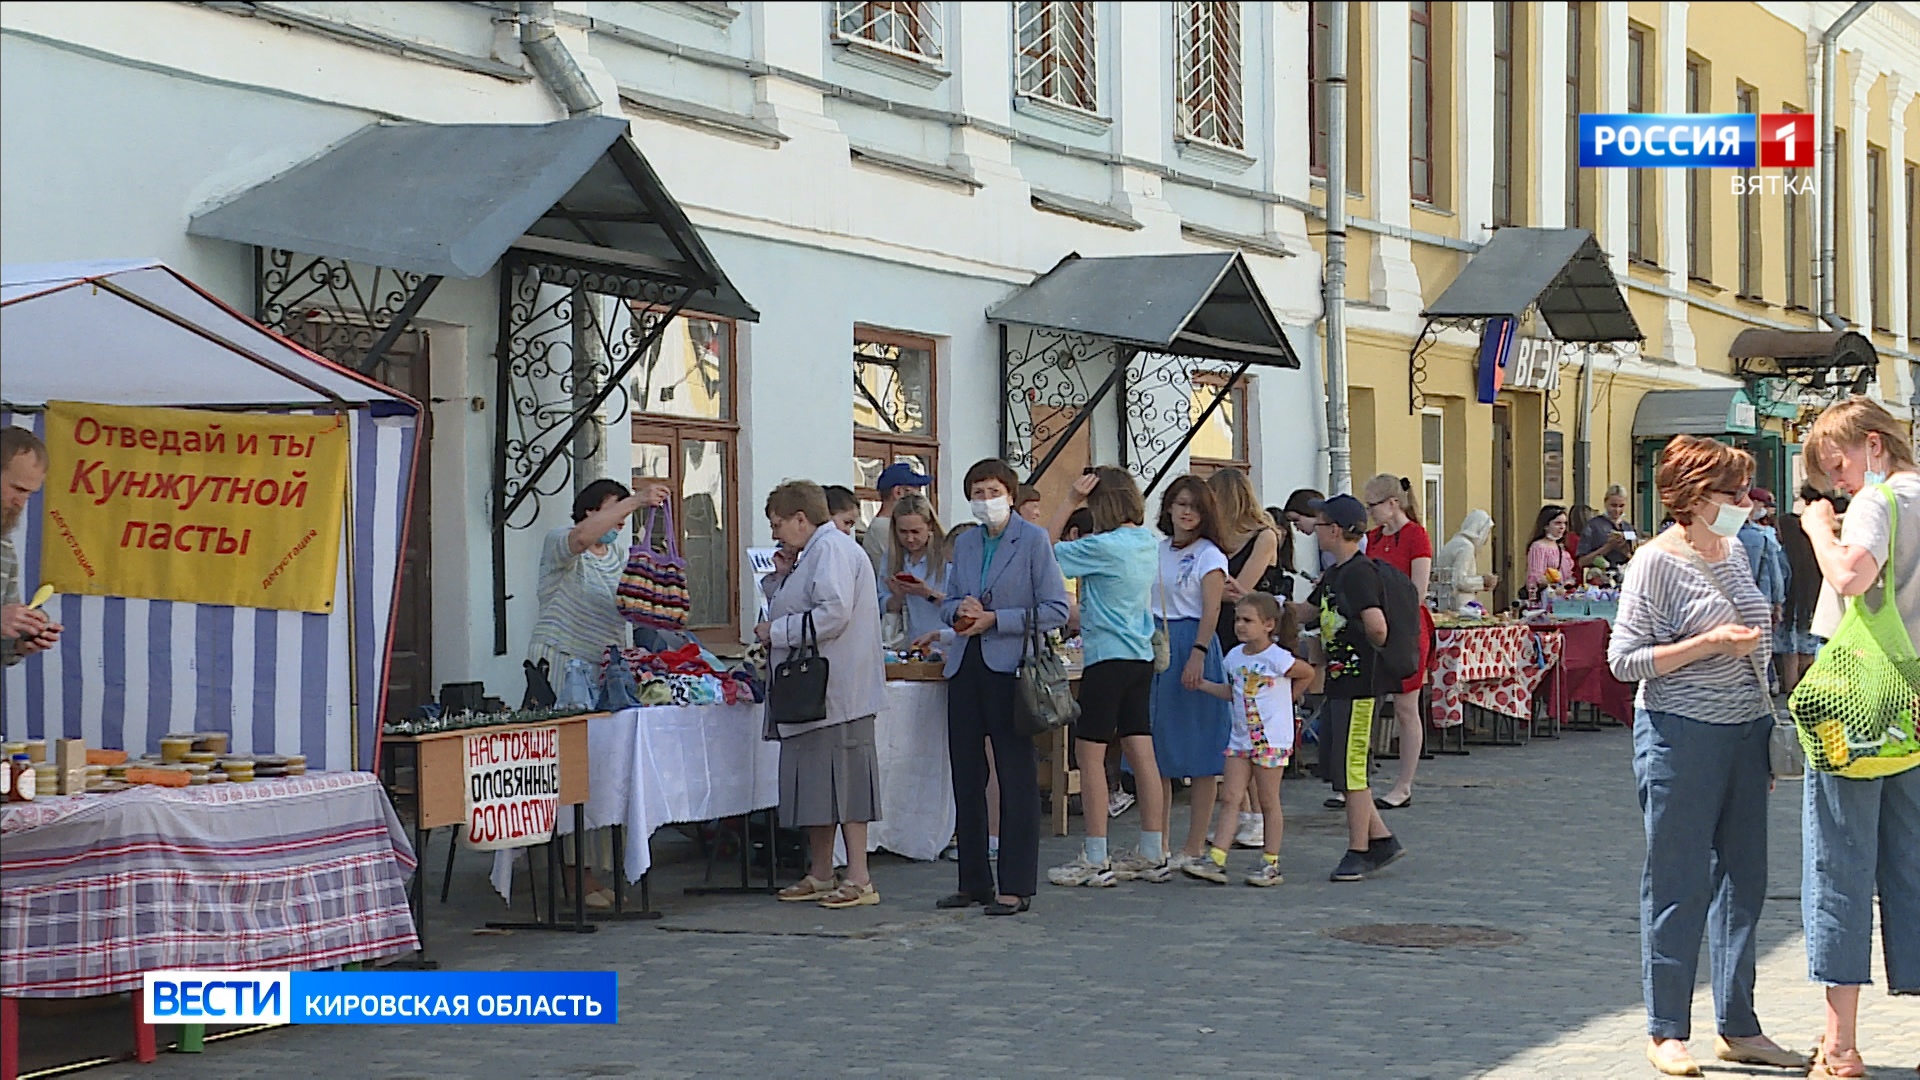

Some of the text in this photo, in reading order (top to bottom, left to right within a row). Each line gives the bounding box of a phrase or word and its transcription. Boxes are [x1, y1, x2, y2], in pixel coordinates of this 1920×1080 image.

[74, 416, 316, 458] Отведай и ты
[69, 457, 310, 511] Кунжутной
[119, 520, 251, 556] пасты
[262, 529, 319, 591] дегустация
[469, 729, 557, 767] НАСТОЯЩИЕ
[471, 763, 559, 803] ОЛОВЯННЫЕ
[469, 797, 558, 843] СОЛДАТИК
